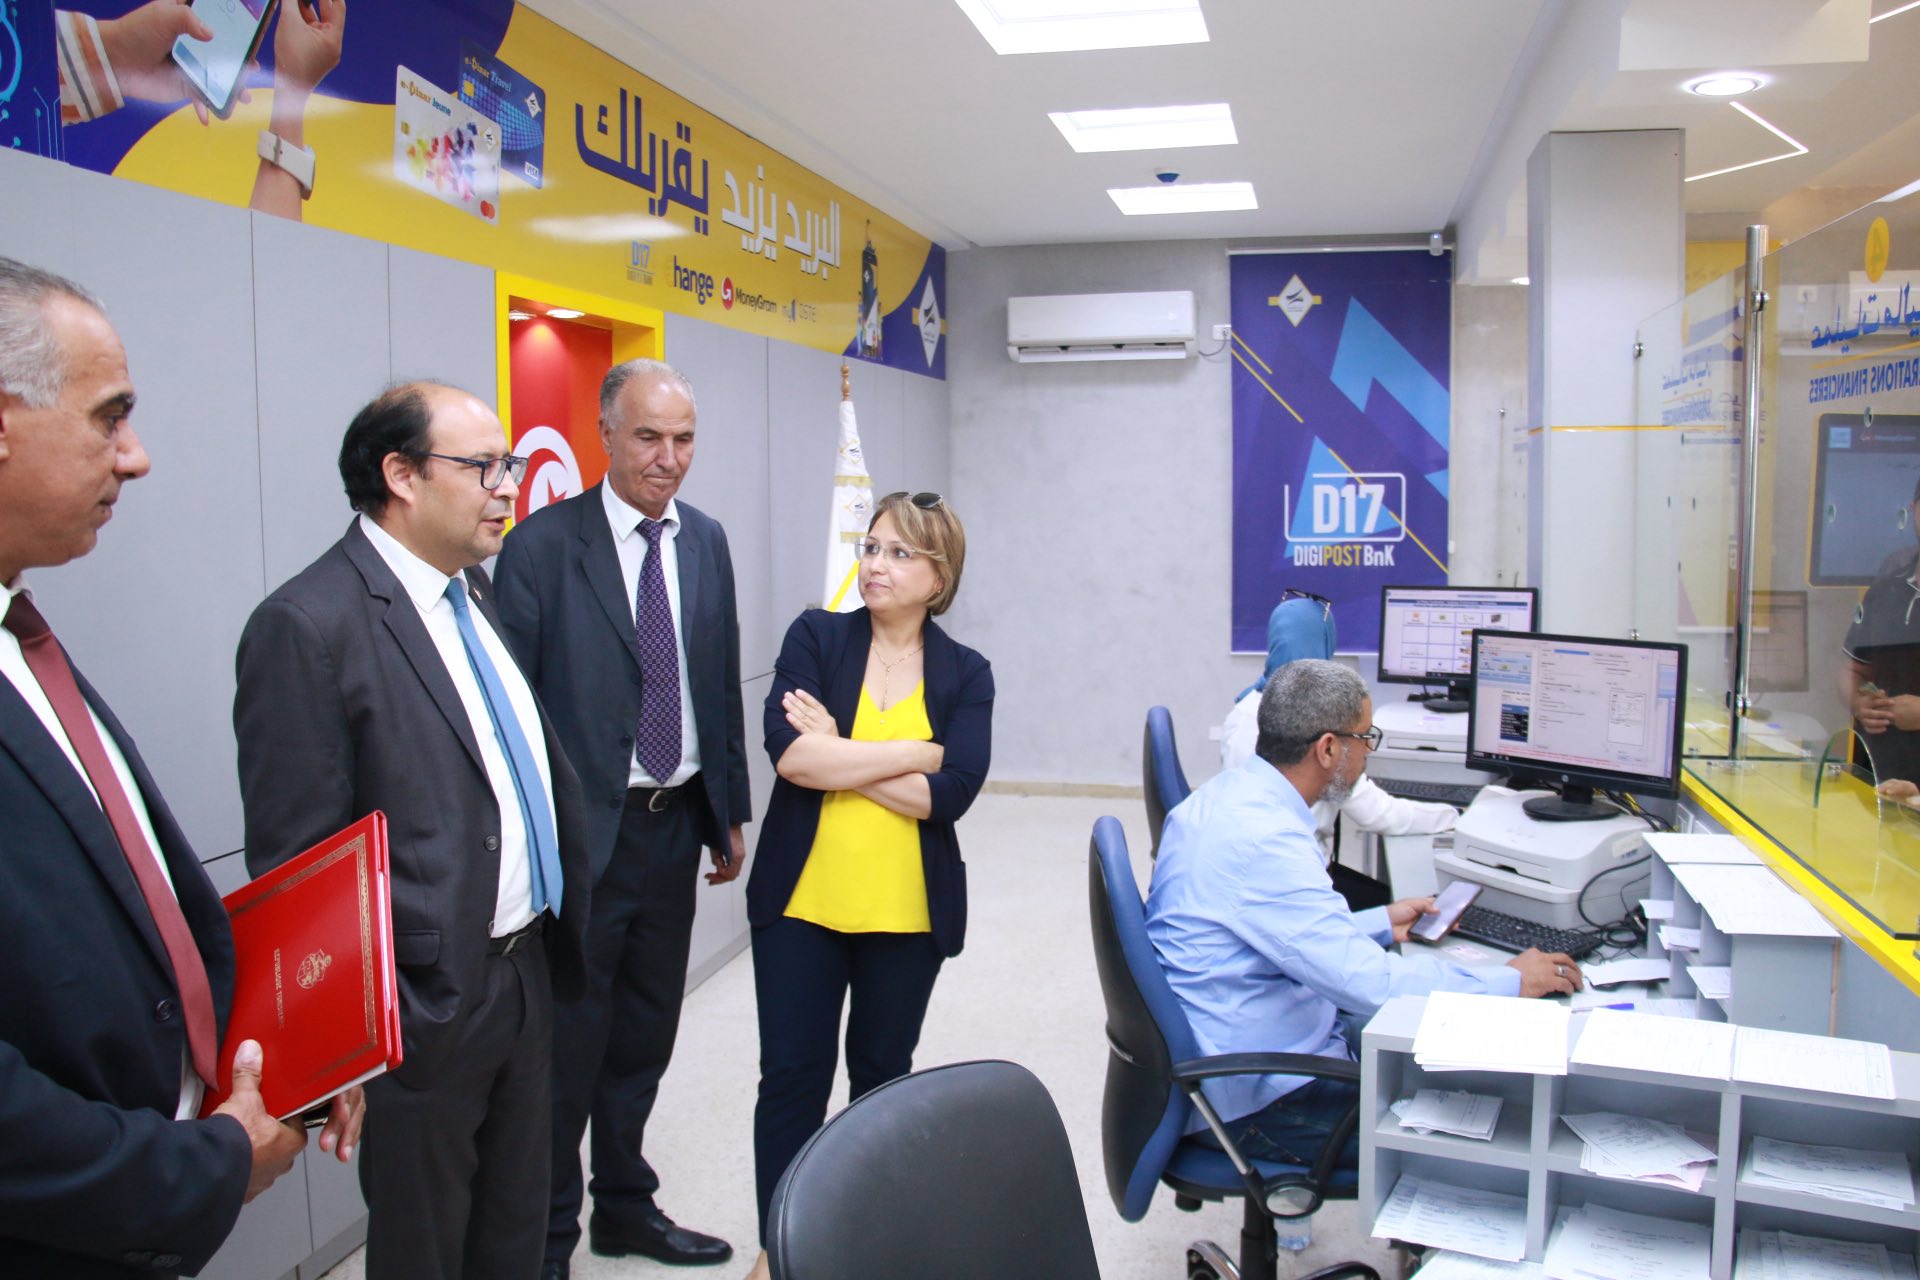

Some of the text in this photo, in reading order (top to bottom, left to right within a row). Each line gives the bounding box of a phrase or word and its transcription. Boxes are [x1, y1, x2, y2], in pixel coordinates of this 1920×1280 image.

[575, 87, 840, 280] البريد يزيد يقربلك
[735, 287, 777, 313] MoneyGram
[1312, 484, 1385, 534] D17
